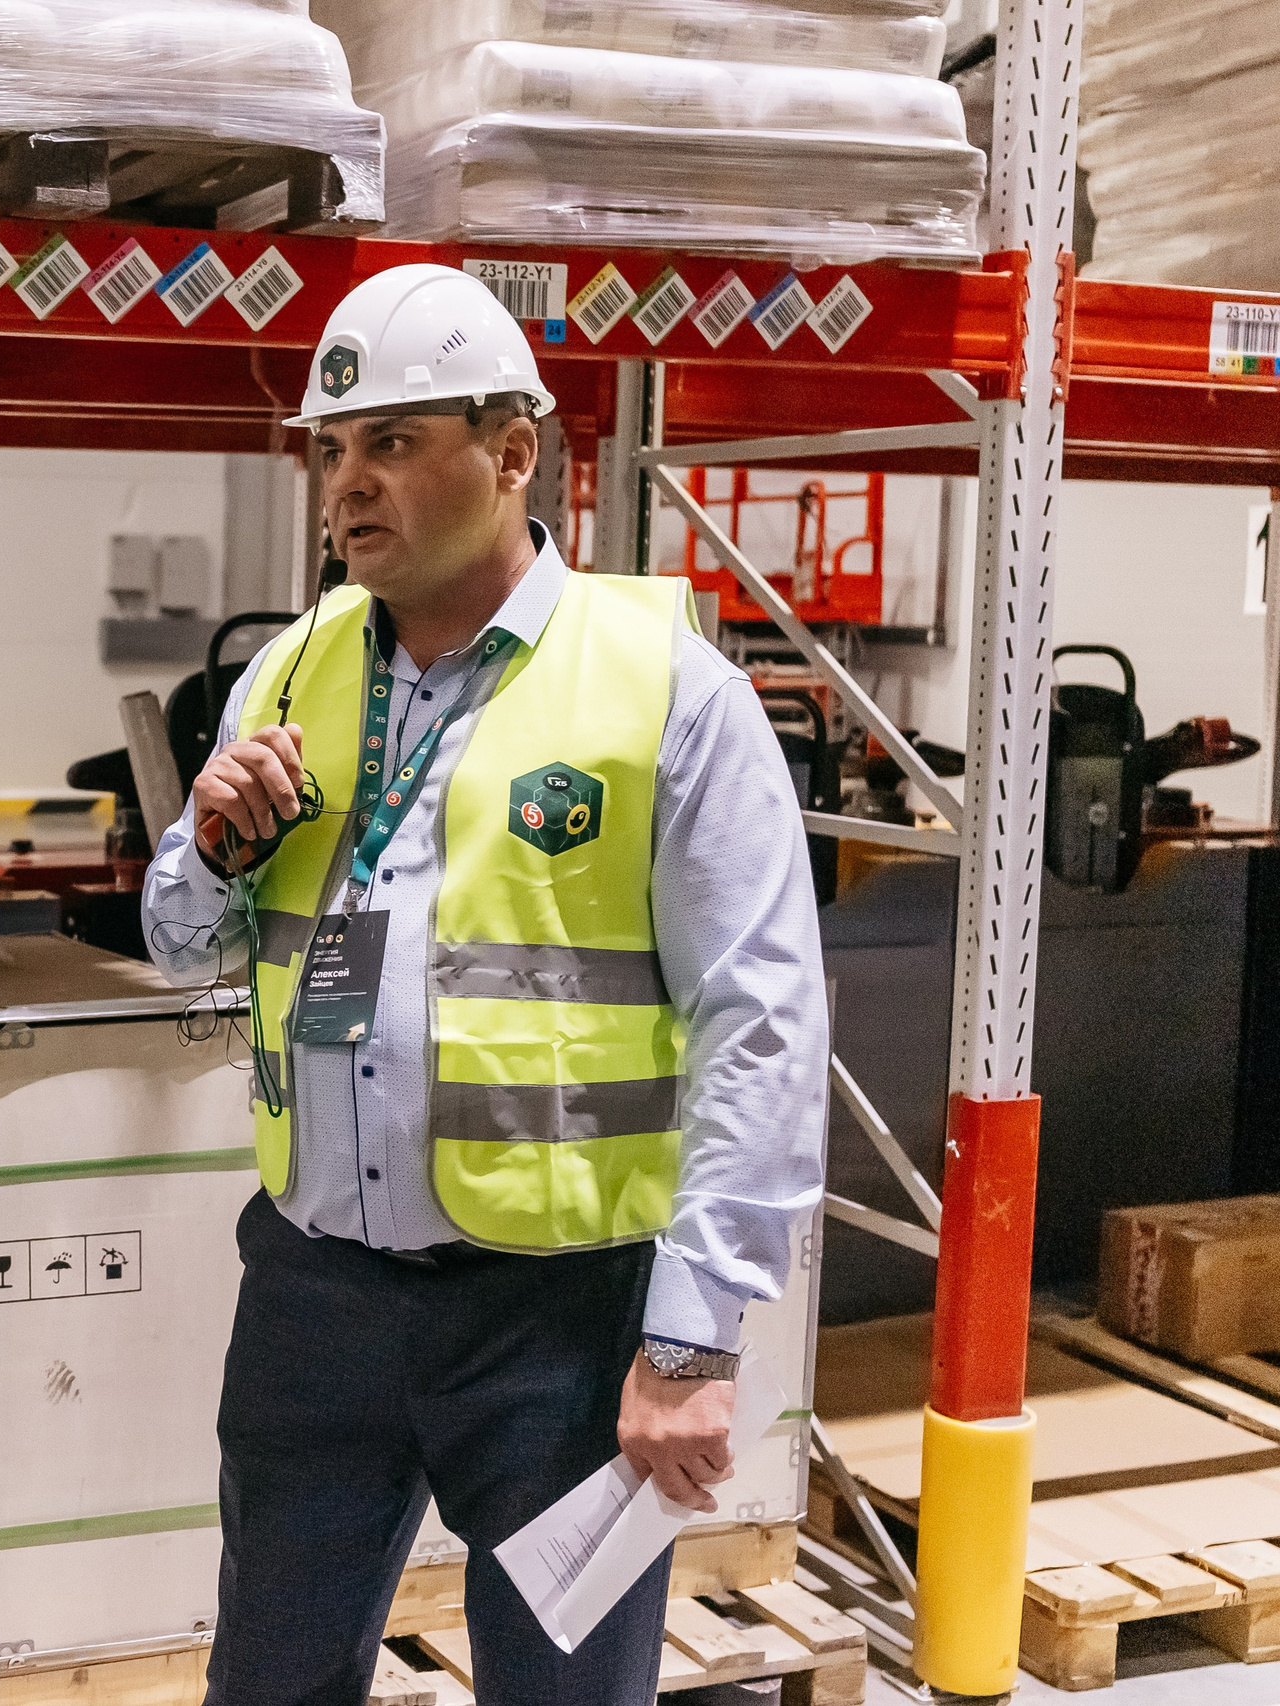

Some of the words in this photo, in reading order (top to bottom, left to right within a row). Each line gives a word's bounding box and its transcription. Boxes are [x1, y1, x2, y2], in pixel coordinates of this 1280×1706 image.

[479, 262, 552, 280] 23-112-Y1
[548, 323, 562, 336] 24
[311, 967, 350, 979] Алексей
